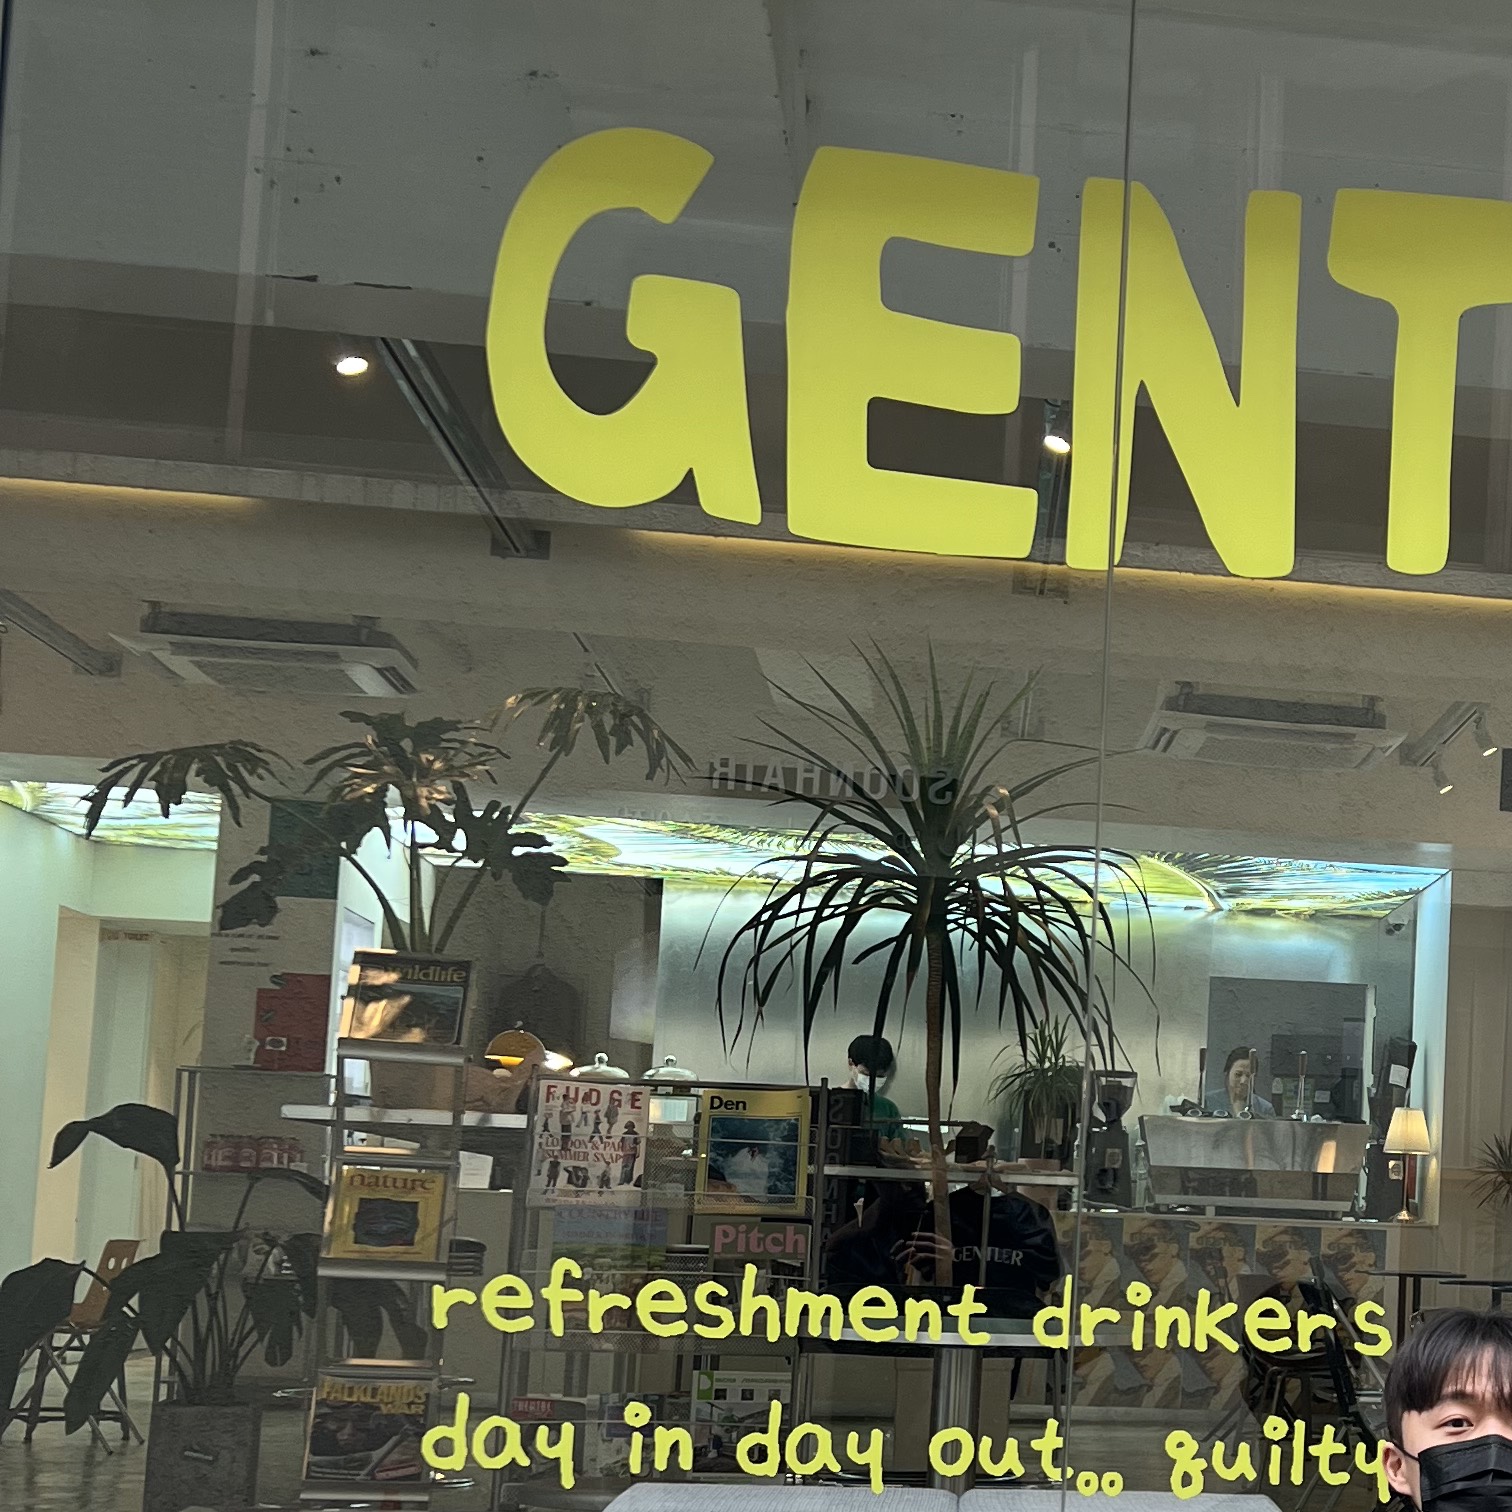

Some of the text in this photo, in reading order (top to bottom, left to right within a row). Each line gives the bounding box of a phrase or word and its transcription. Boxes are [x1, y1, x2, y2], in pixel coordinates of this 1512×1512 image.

[545, 1084, 643, 1111] FUDGE
[709, 1095, 747, 1111] Den
[545, 1136, 588, 1150] LODON
[350, 1173, 436, 1192] nature
[714, 1224, 806, 1254] Pitch
[952, 1246, 1024, 1267] GENTLER
[432, 1257, 1393, 1357] refreshment drinkers
[321, 1376, 427, 1403] FALKLANDS
[420, 1393, 575, 1490] day
[623, 1401, 694, 1475] in
[735, 1400, 884, 1495] day
[1164, 1416, 1391, 1504] guilty
